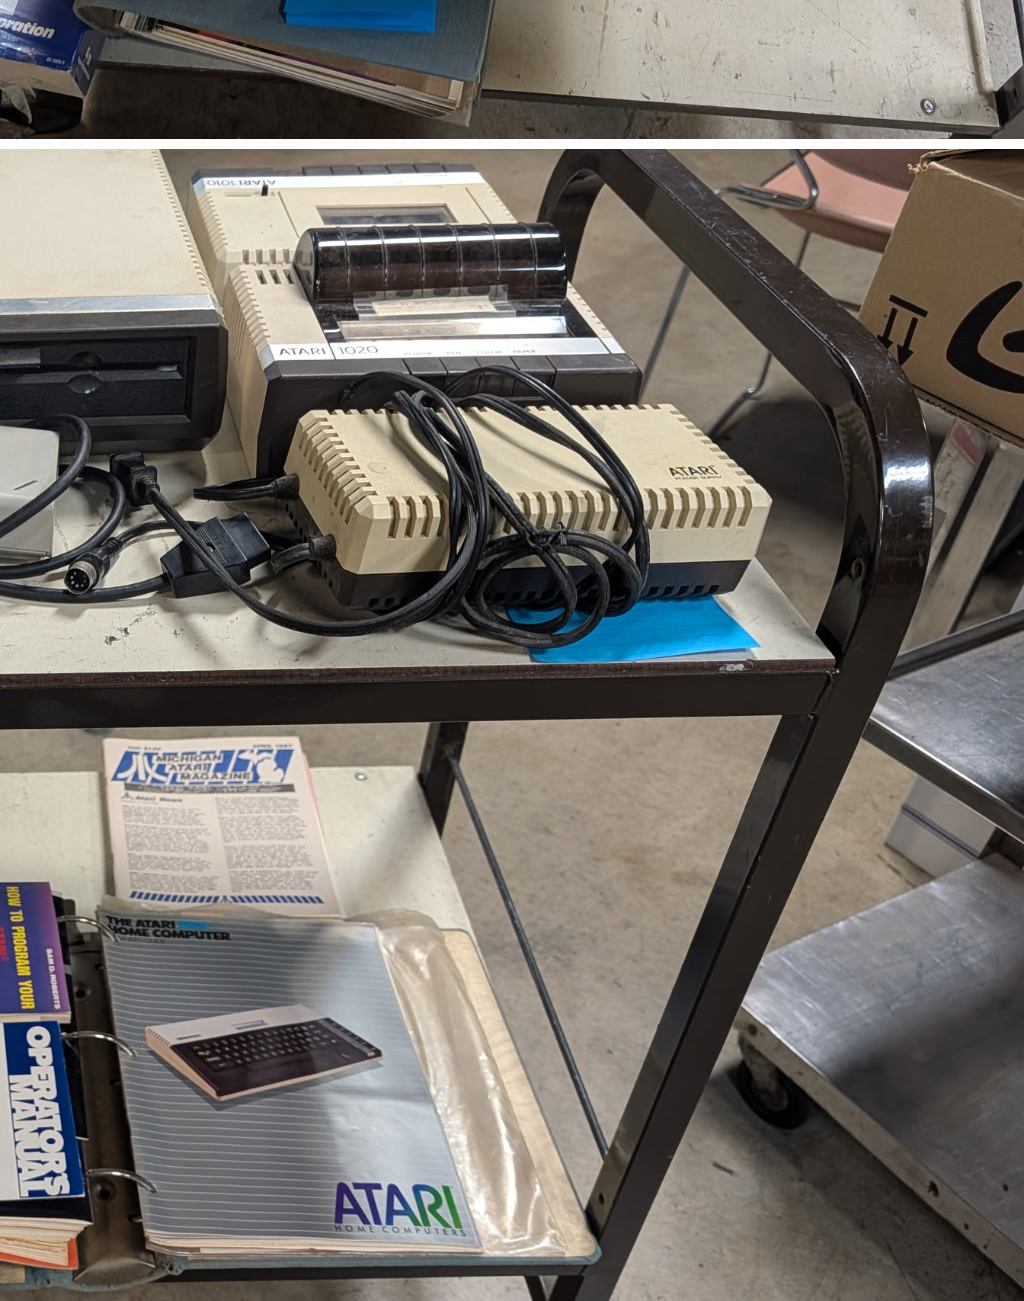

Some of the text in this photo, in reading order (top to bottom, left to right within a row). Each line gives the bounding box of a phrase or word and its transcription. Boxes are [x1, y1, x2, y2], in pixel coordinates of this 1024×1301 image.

[206, 179, 235, 187] 1010
[279, 346, 380, 356] ATARI 1020
[669, 465, 719, 477] ATARI
[155, 754, 222, 762] MICHIGAN
[180, 772, 252, 781] MAGAZINE
[105, 915, 134, 927] THE
[135, 919, 176, 929] ATARI
[108, 924, 151, 937] HOME
[152, 929, 232, 941] COMPUTER
[6, 886, 36, 1010] HOW TO PROGRAM YOUR
[26, 1025, 71, 1198] OPERATOR'S
[8, 1074, 38, 1198] MANUAL
[334, 1181, 464, 1230] ATARI
[334, 1225, 466, 1238] HOME COMPUTERS
